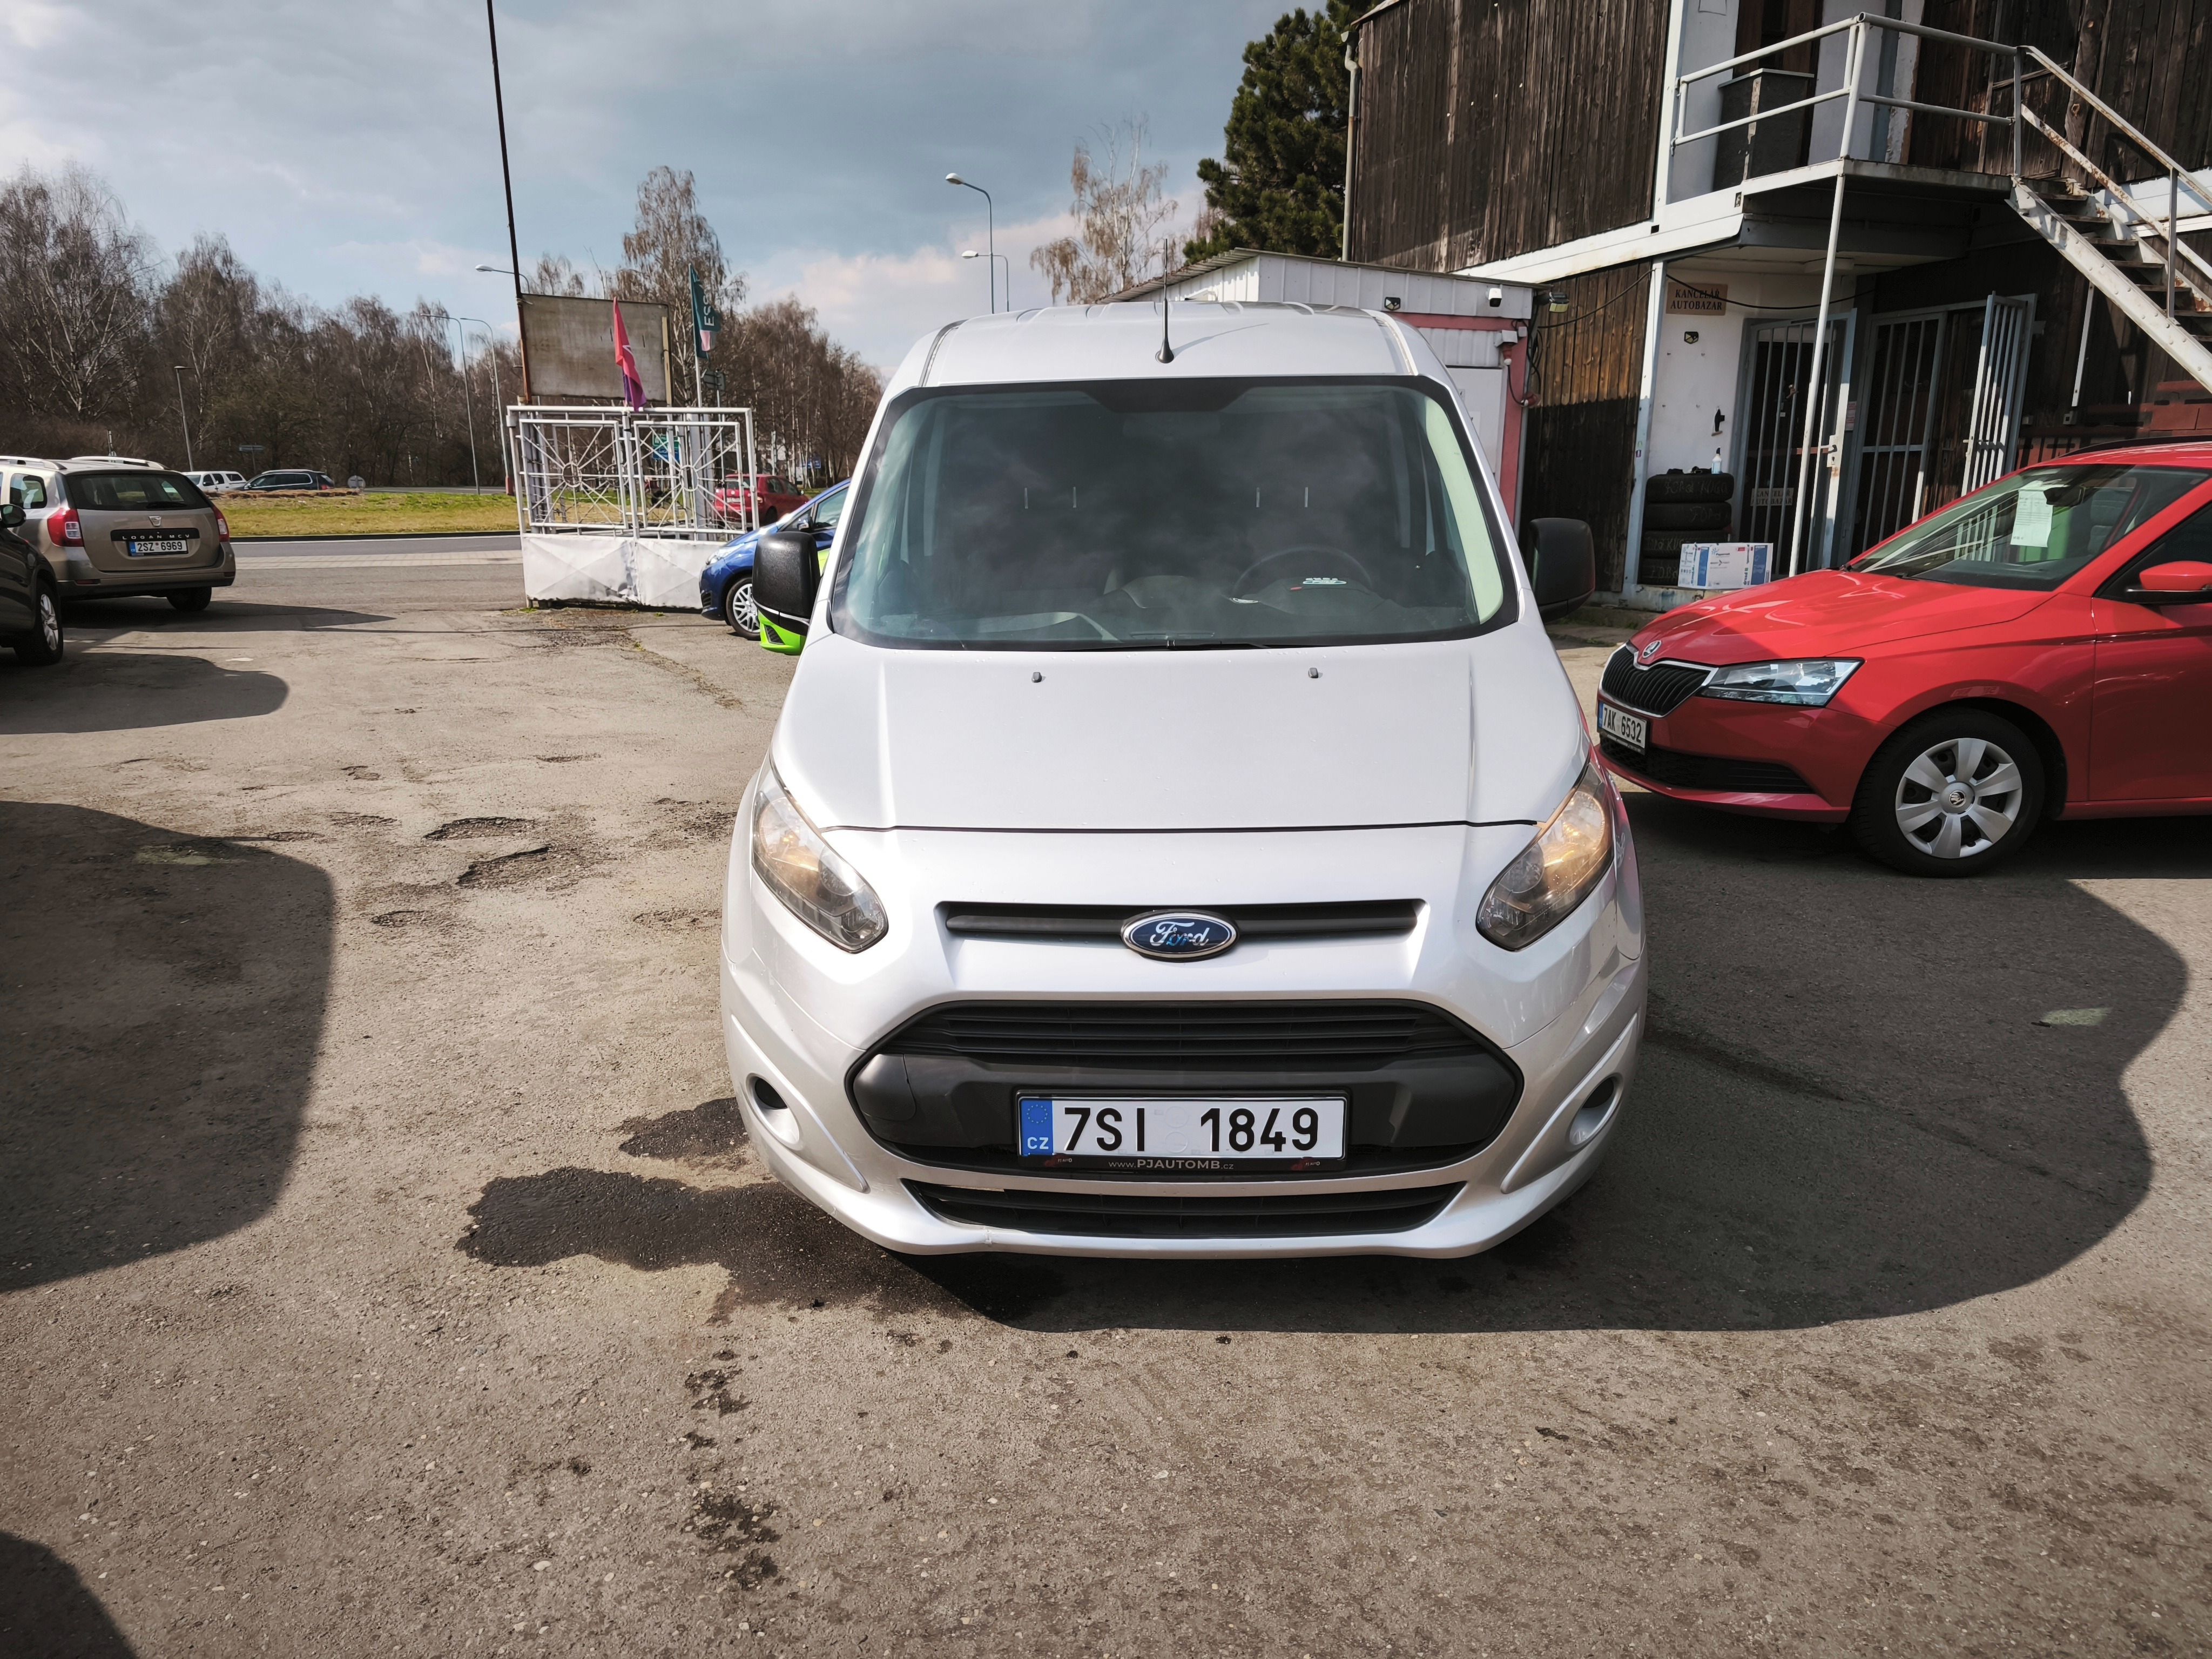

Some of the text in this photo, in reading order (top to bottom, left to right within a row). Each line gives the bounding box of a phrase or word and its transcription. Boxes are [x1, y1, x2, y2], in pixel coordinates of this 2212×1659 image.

[1670, 300, 1722, 310] AUTOBAZAR
[137, 542, 183, 552] 2SZ 6969
[1603, 707, 1642, 743] 7AK 6532
[1150, 921, 1210, 946] Ford
[1064, 1107, 1318, 1152] 7SI 1849
[1027, 1137, 1049, 1150] CZ
[1108, 1159, 1234, 1170] www.PJAUTOMB.cz
